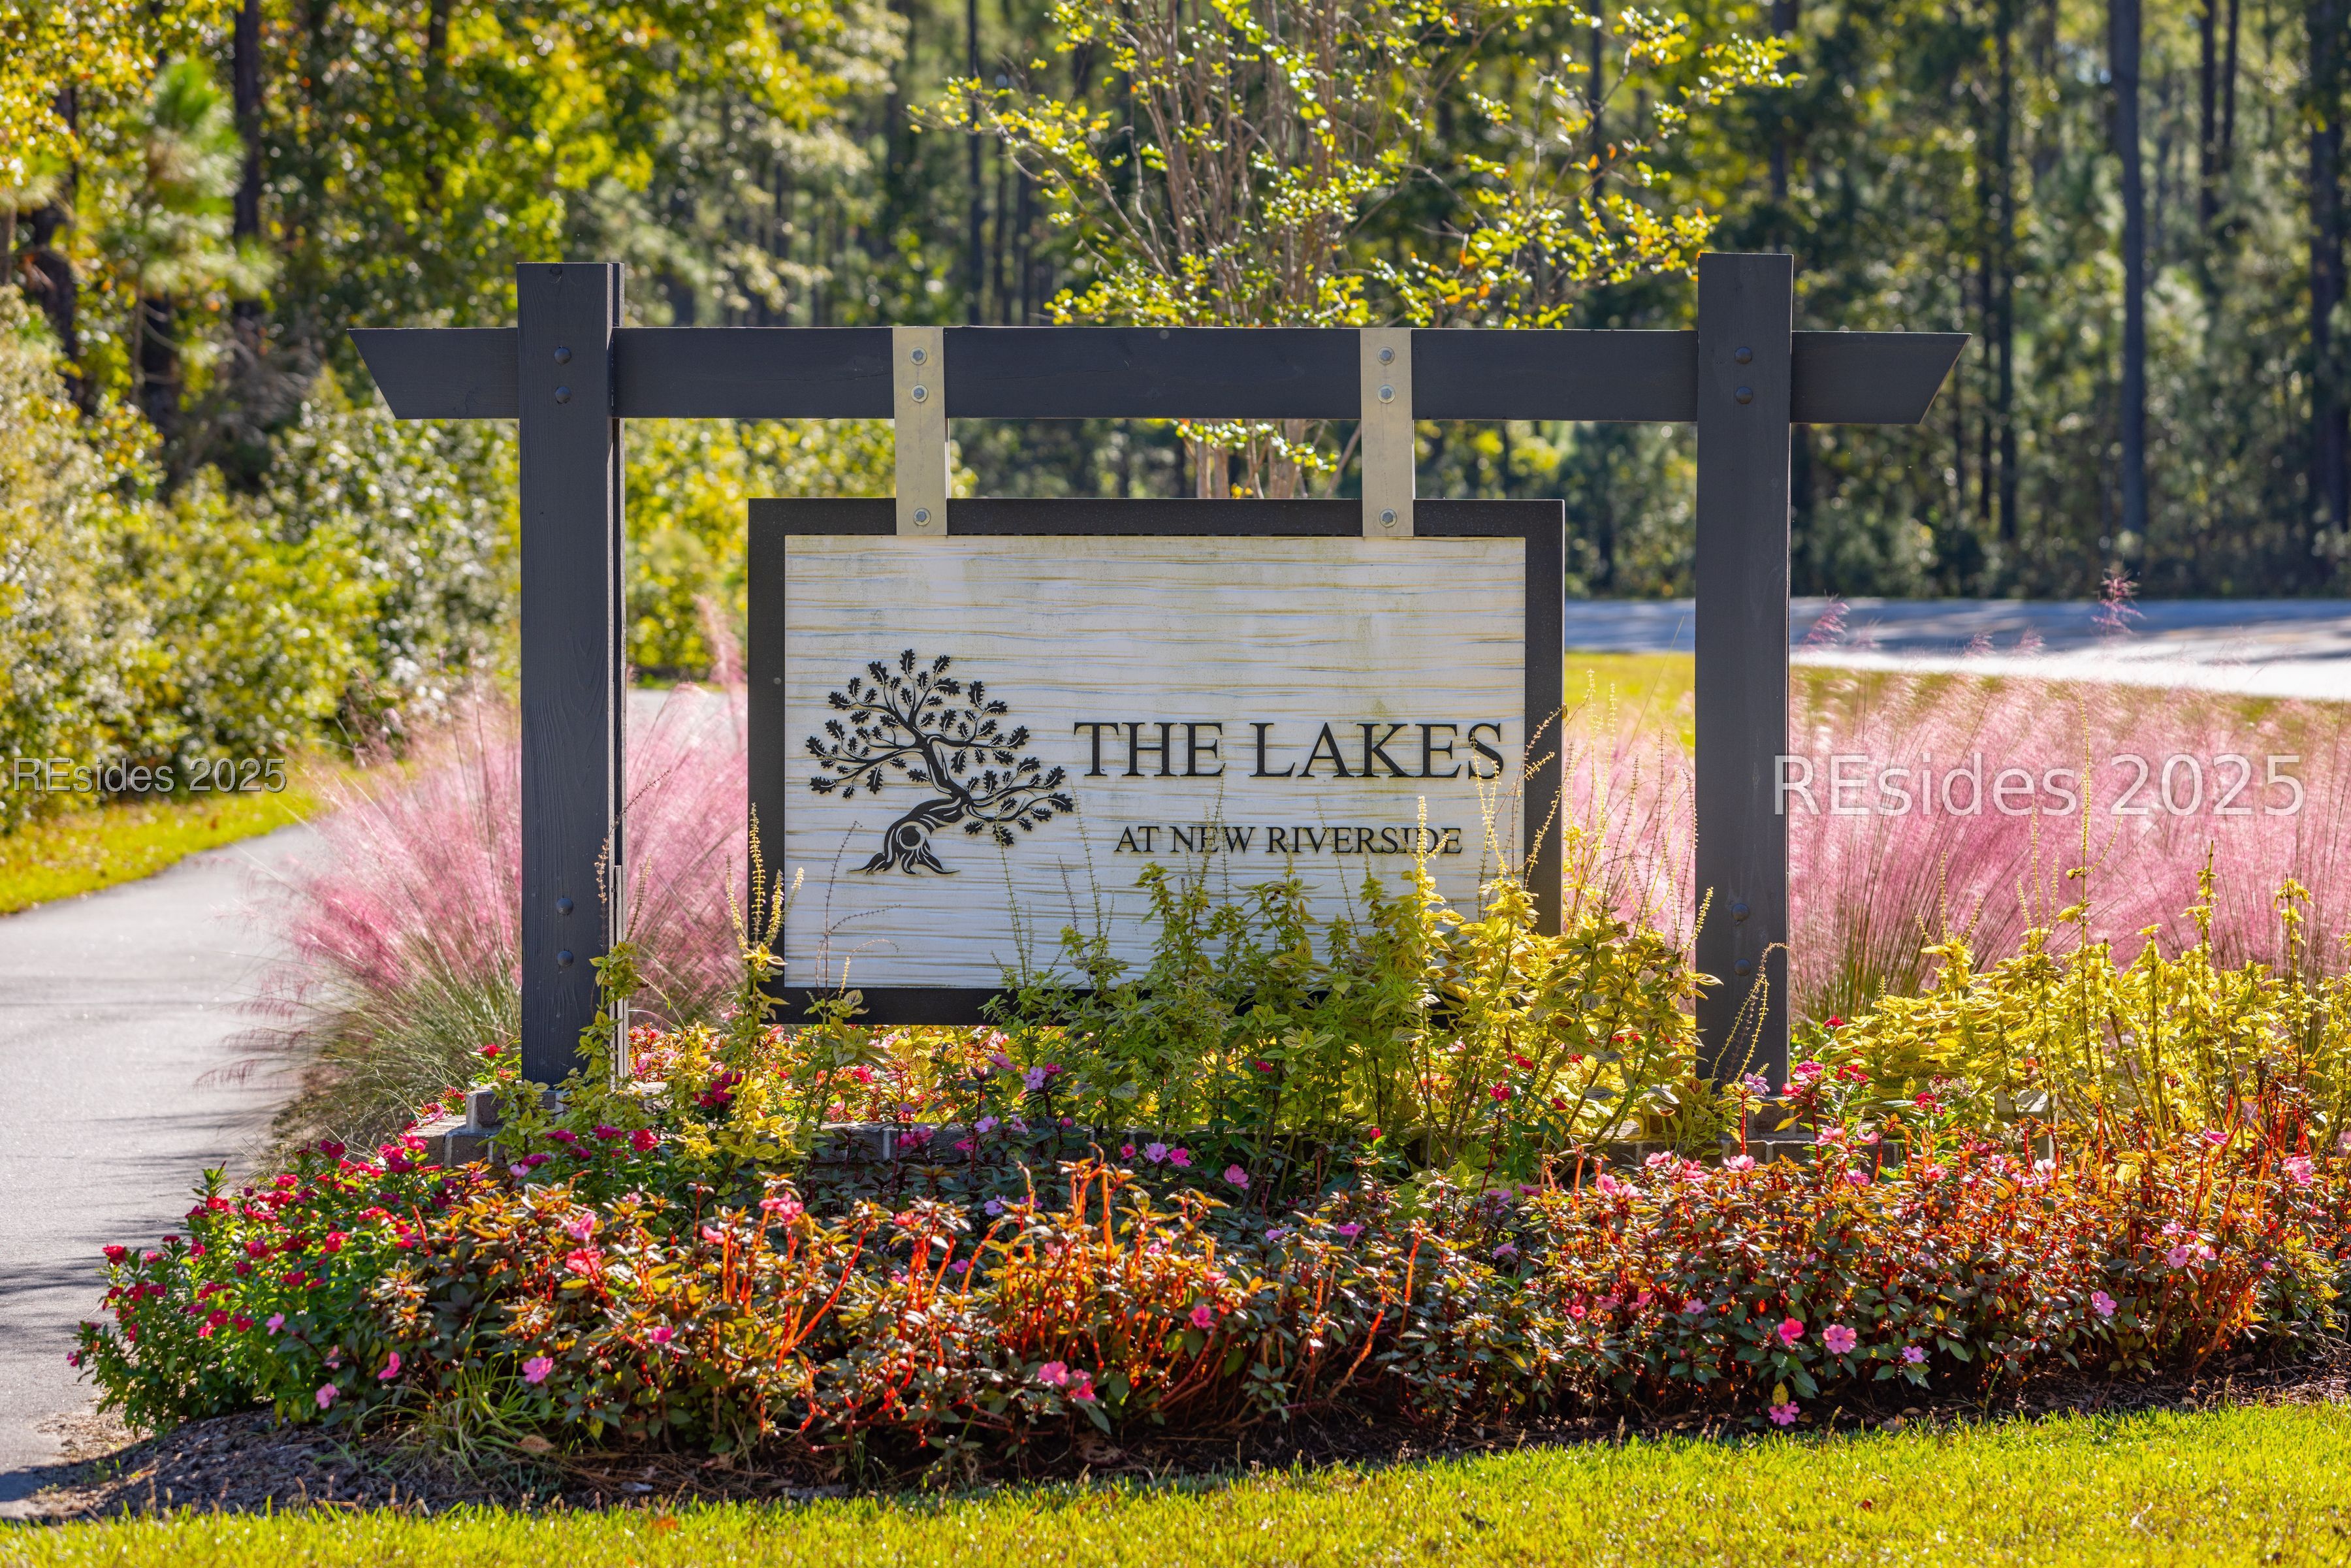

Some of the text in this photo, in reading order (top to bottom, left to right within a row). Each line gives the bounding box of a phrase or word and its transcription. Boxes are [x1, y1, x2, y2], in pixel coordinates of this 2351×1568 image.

[1074, 722, 1504, 780] THE LAKES
[1114, 825, 1463, 854] AT NEW RIVERSIDE
